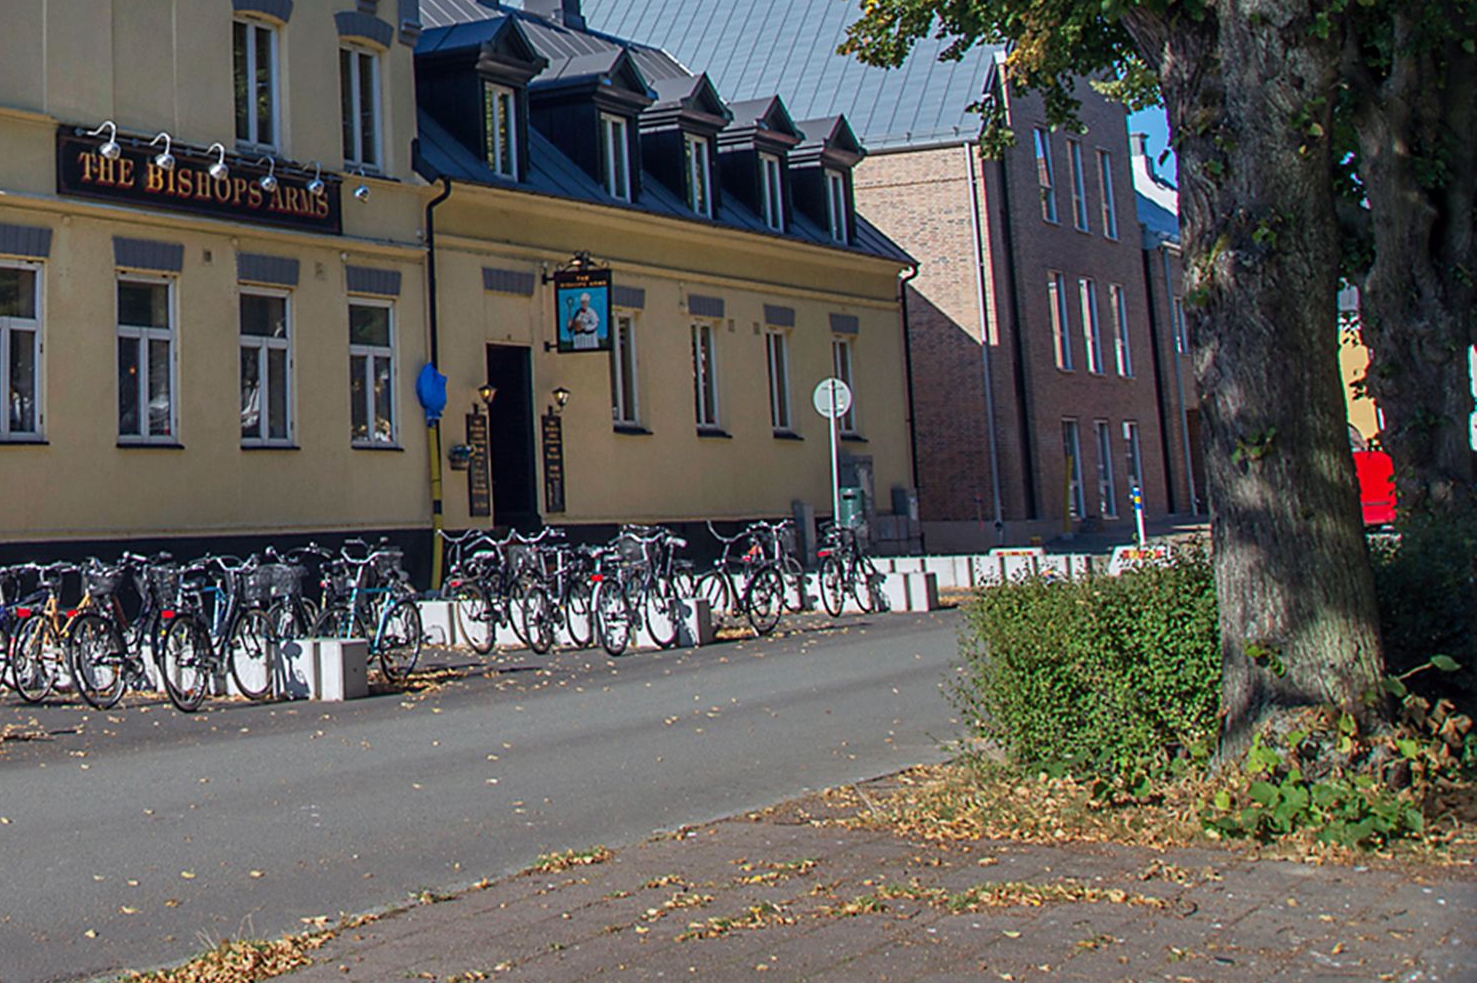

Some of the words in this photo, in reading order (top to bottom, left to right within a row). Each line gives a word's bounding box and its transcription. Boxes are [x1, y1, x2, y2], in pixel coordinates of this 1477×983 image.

[78, 151, 135, 188] THE
[145, 162, 263, 208] BISHOPS
[268, 184, 330, 217] ARMS
